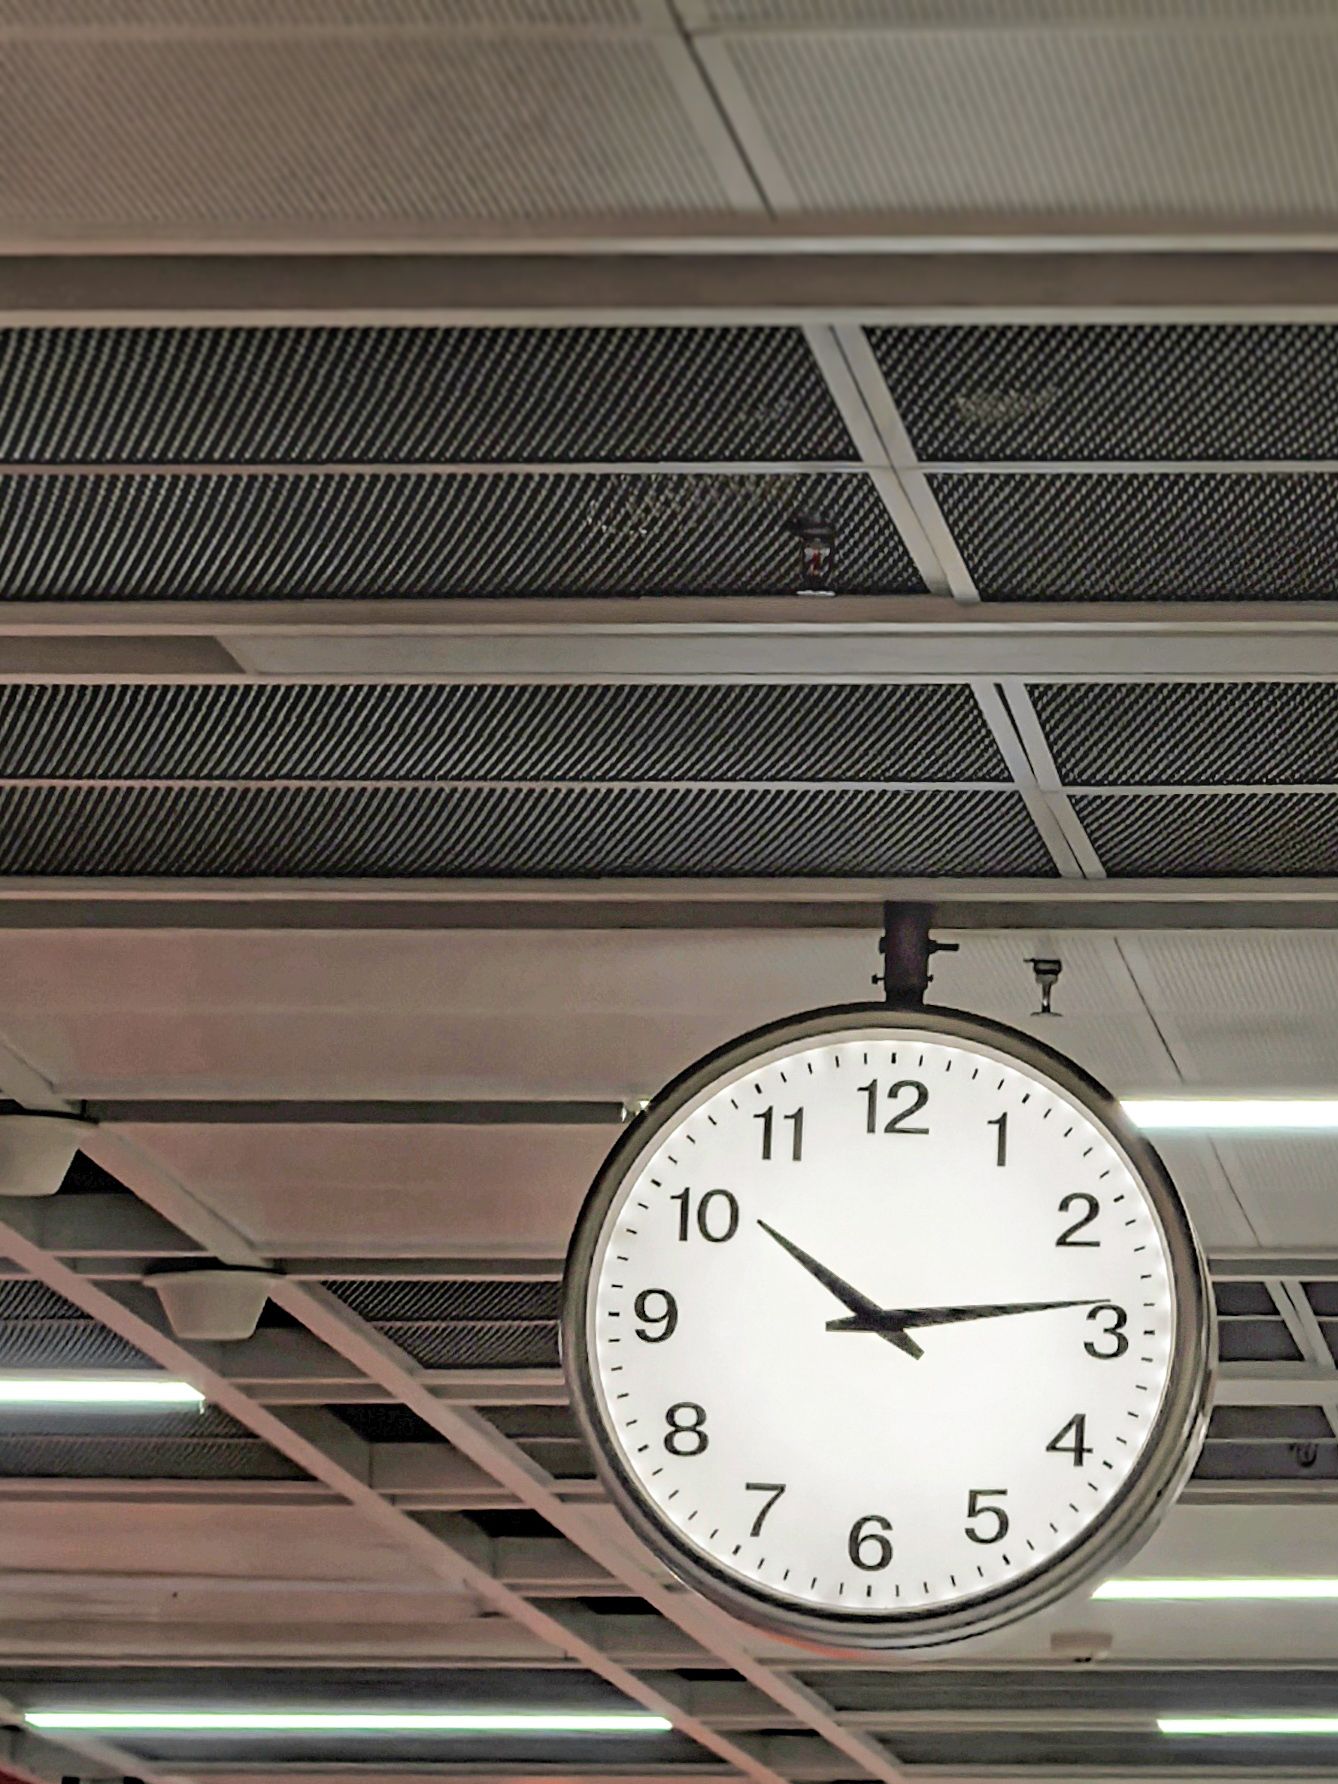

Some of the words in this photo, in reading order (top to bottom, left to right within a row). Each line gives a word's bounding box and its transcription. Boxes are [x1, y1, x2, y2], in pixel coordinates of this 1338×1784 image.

[753, 1106, 805, 1161] 11
[857, 1079, 930, 1134] 12
[987, 1112, 1008, 1167] 1
[670, 1187, 739, 1243] 10
[1055, 1193, 1101, 1248] 2
[634, 1289, 678, 1343] 9
[1083, 1304, 1129, 1360] 3
[663, 1402, 709, 1457] 8
[1045, 1413, 1093, 1467] 4
[745, 1483, 786, 1537] 7
[964, 1489, 1009, 1545] 5
[848, 1515, 893, 1572] 6
